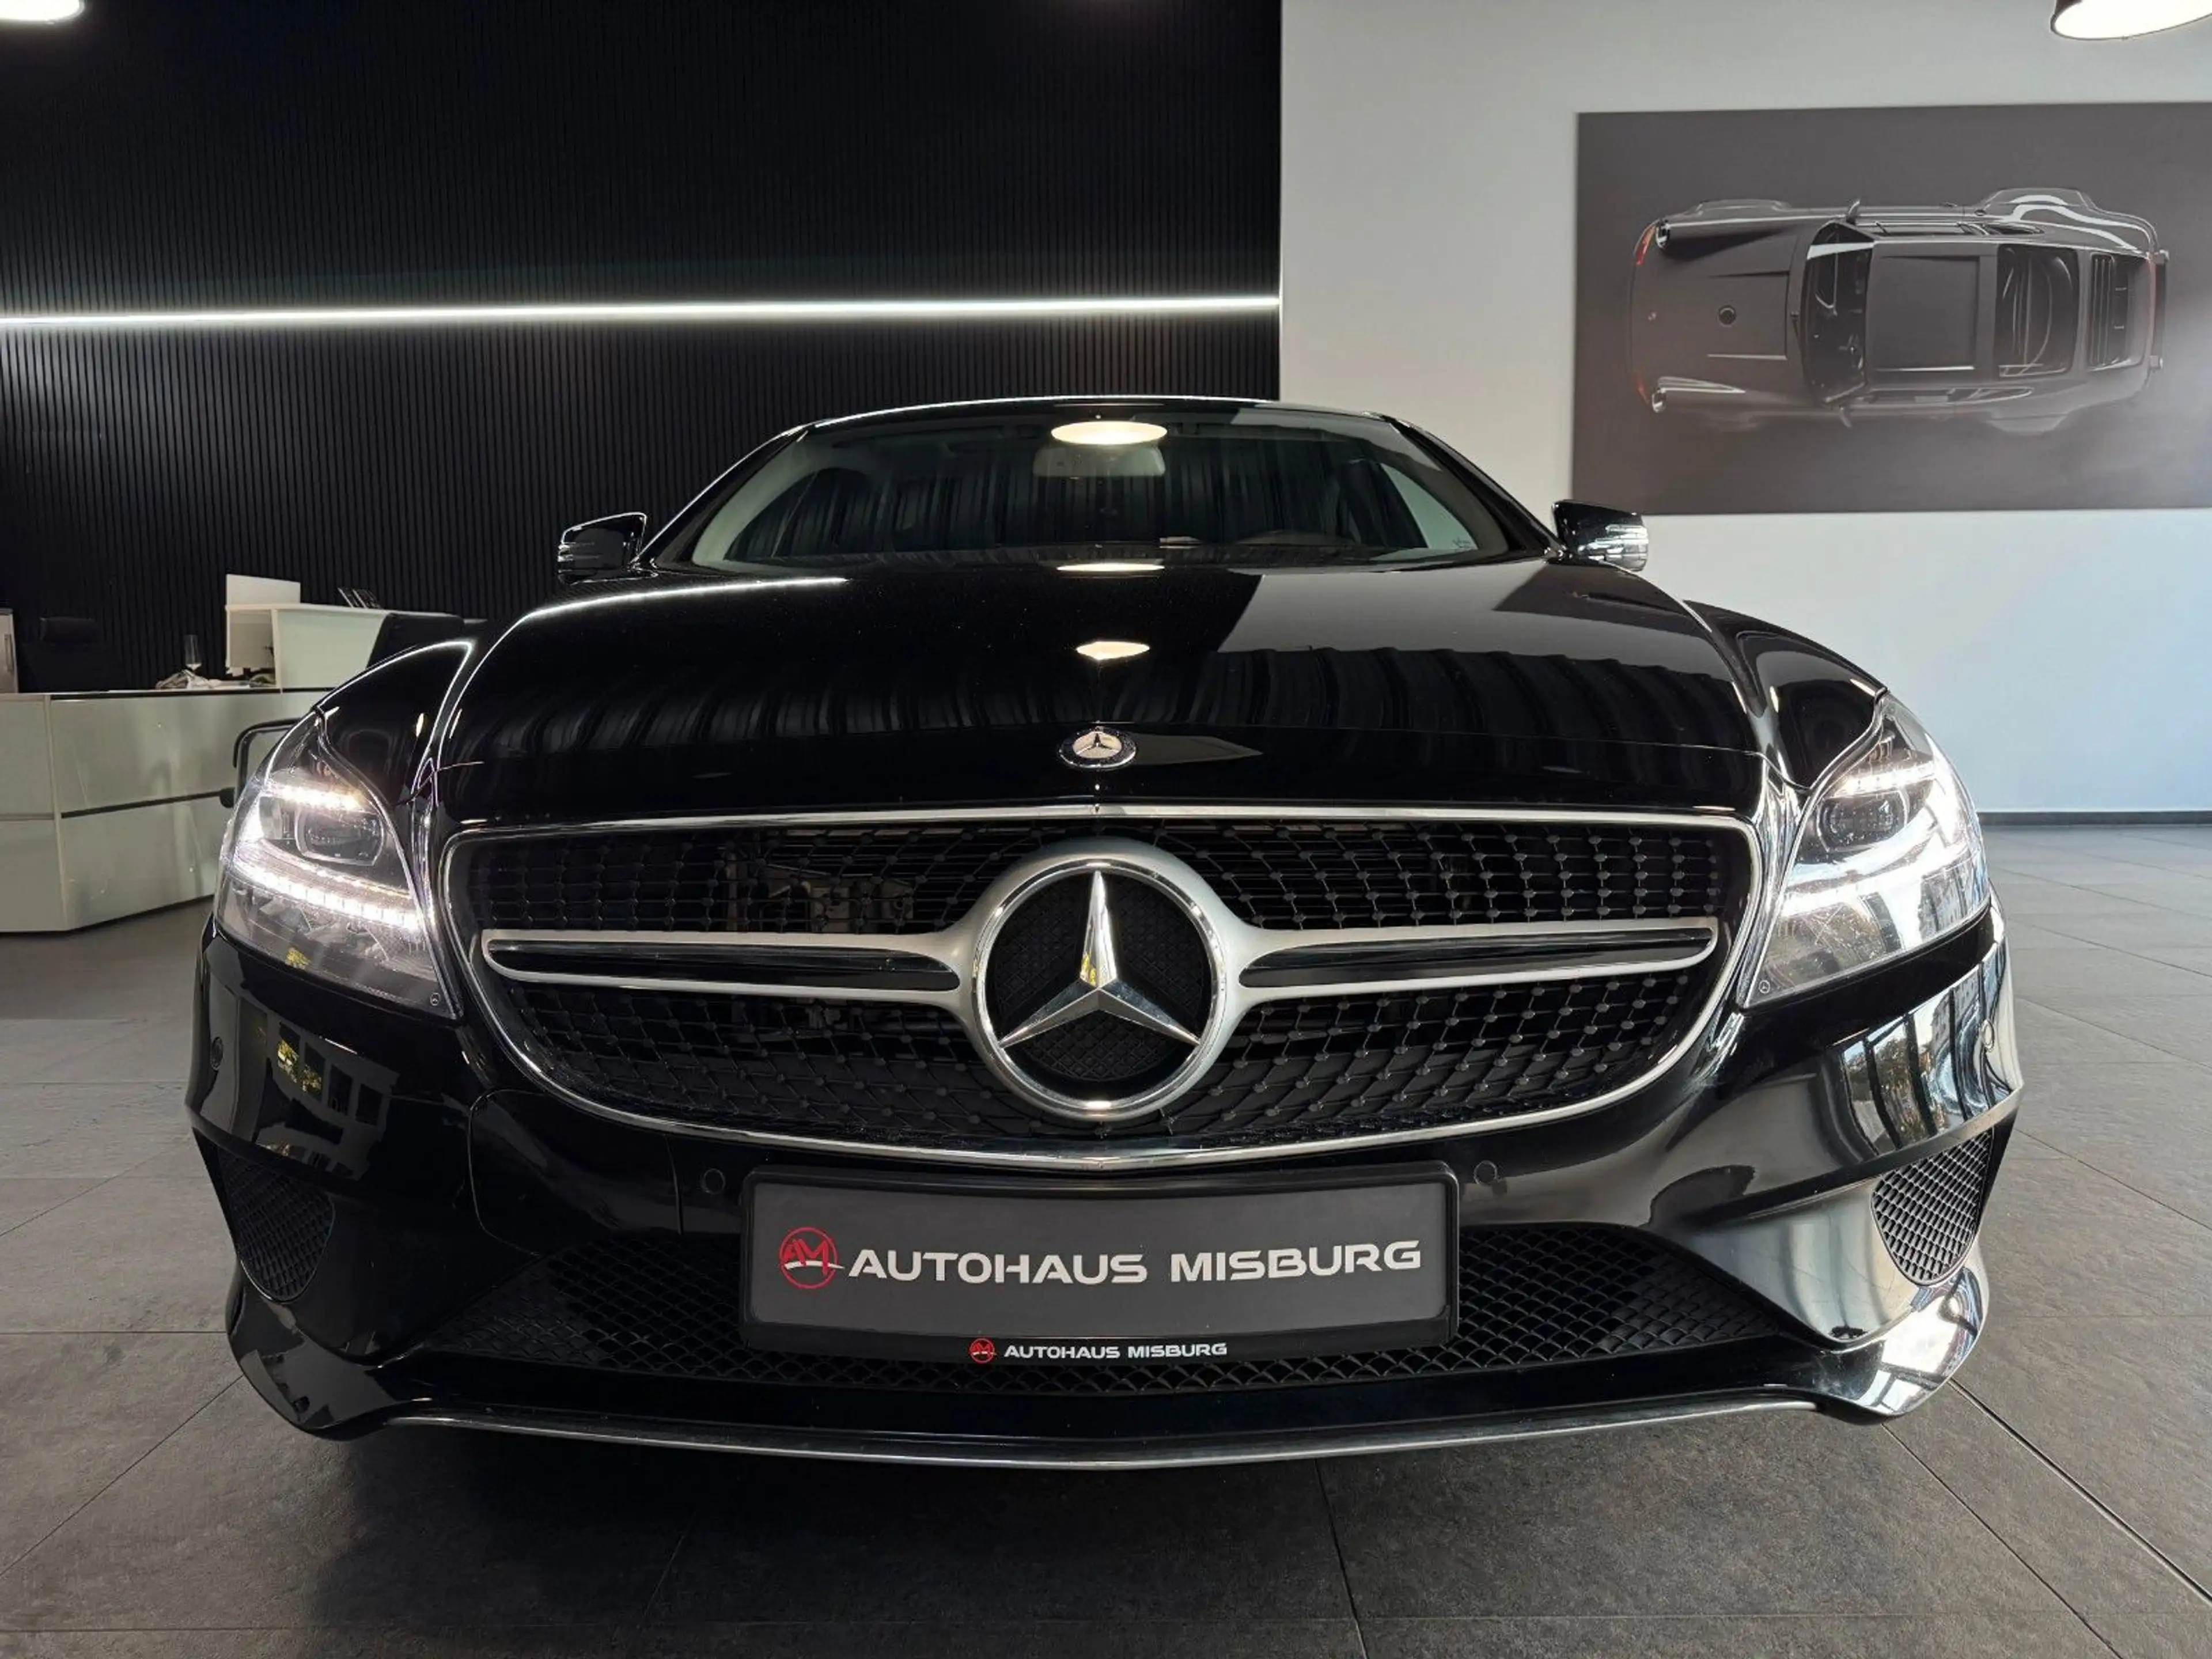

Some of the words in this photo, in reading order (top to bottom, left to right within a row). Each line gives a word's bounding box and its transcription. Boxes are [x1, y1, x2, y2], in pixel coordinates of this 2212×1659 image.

[849, 1249, 1147, 1284] AUTOHAUS
[1171, 1240, 1421, 1282] MISBURG
[1004, 1345, 1120, 1359] AUTOHAUS
[1127, 1343, 1228, 1358] MISBURG
